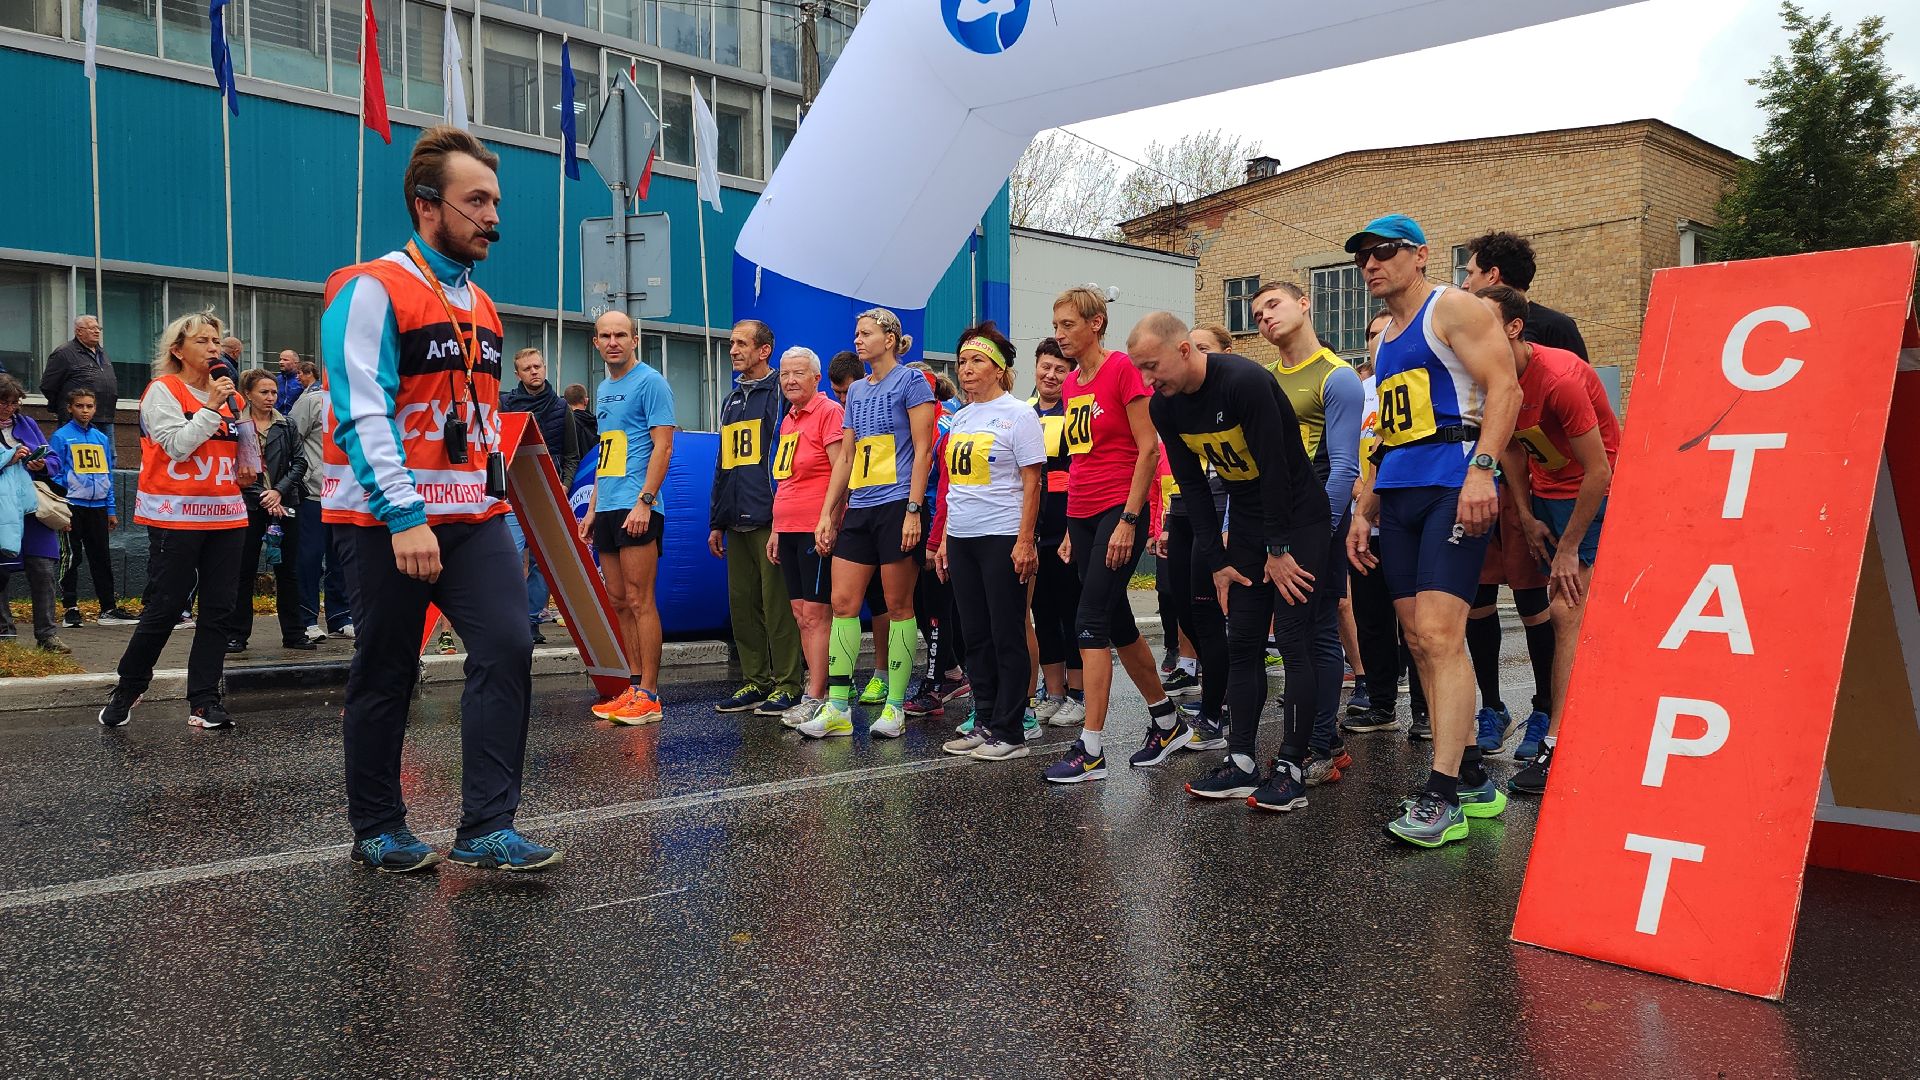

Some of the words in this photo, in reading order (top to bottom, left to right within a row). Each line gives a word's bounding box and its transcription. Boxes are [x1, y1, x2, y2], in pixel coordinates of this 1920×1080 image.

[426, 339, 461, 360] Arta
[1068, 405, 1091, 445] 20
[1381, 384, 1413, 434] 49
[76, 449, 101, 469] 150
[951, 441, 974, 475] 18
[1203, 441, 1249, 473] 44
[1624, 306, 1811, 936] СТАРТ
[930, 642, 938, 657] do
